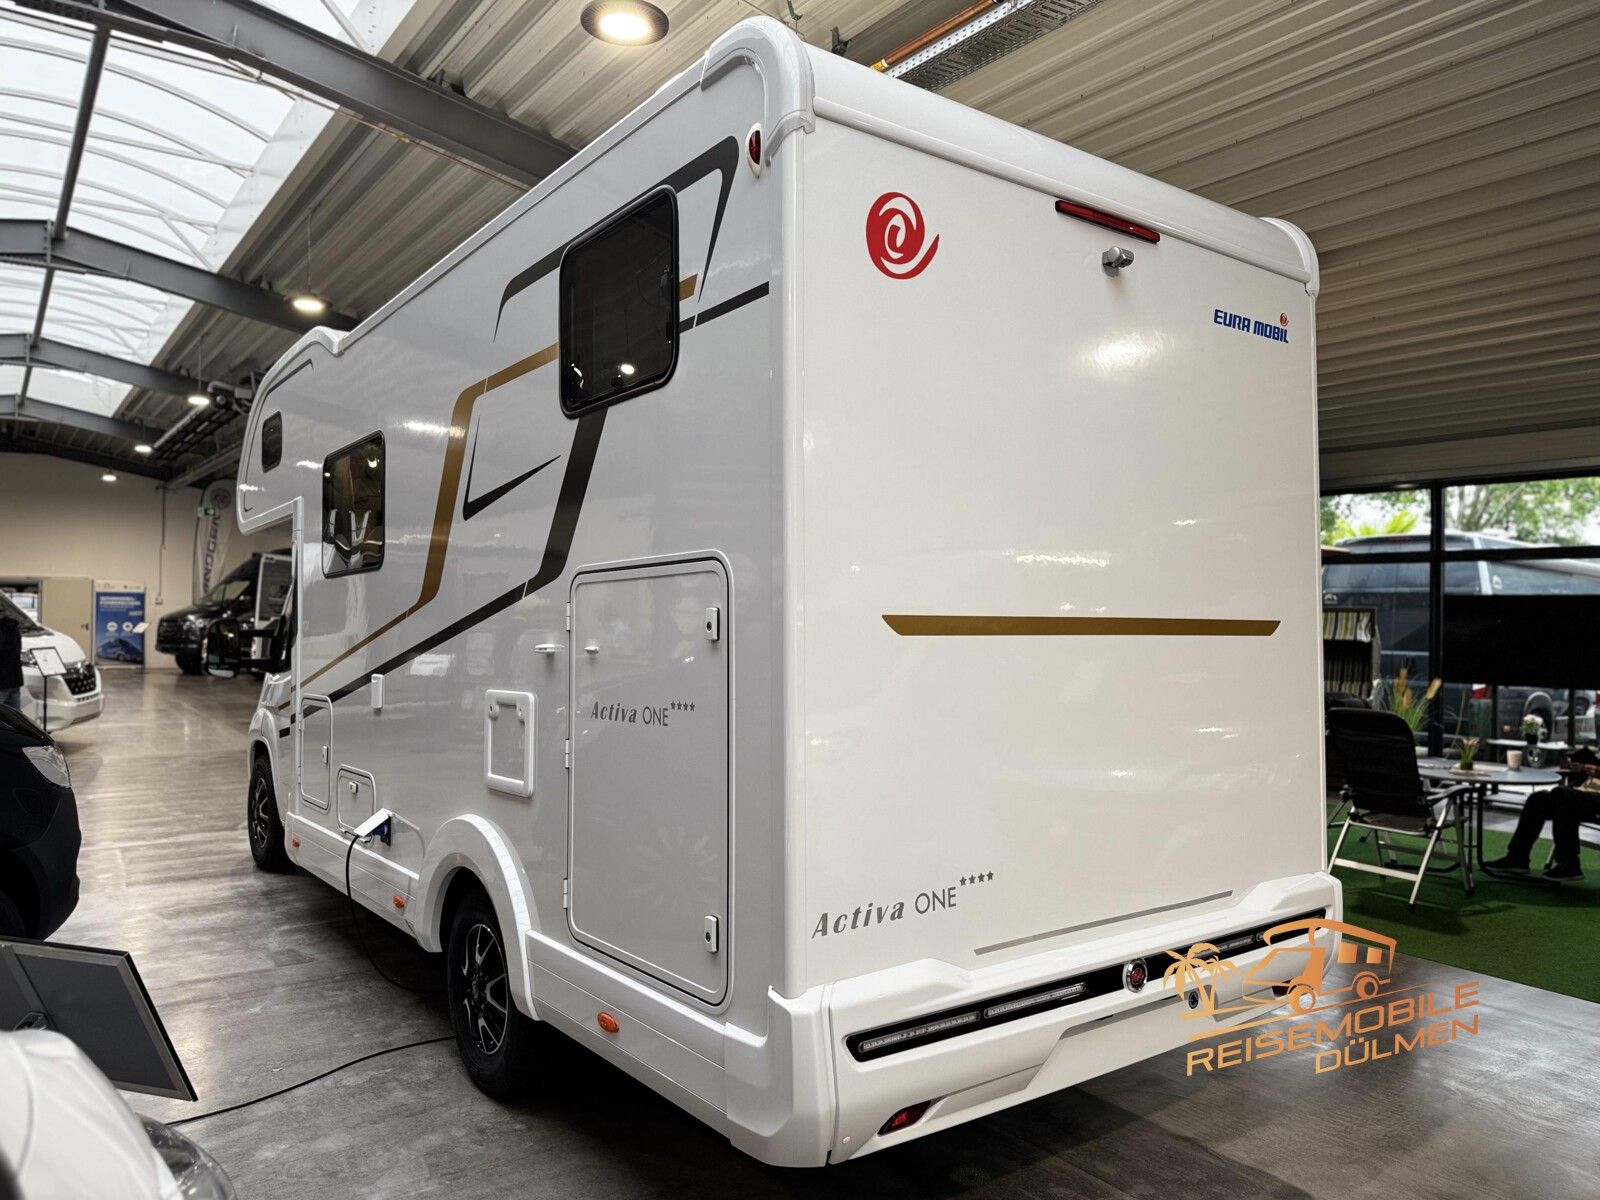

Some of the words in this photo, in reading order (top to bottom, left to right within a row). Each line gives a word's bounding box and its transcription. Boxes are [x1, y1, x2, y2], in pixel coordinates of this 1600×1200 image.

[1213, 308, 1251, 333] EURA
[1253, 320, 1289, 344] MOBIL
[591, 701, 637, 723] Activa
[642, 706, 669, 727] ONE
[811, 901, 905, 939] Activa
[914, 886, 957, 915] ONE
